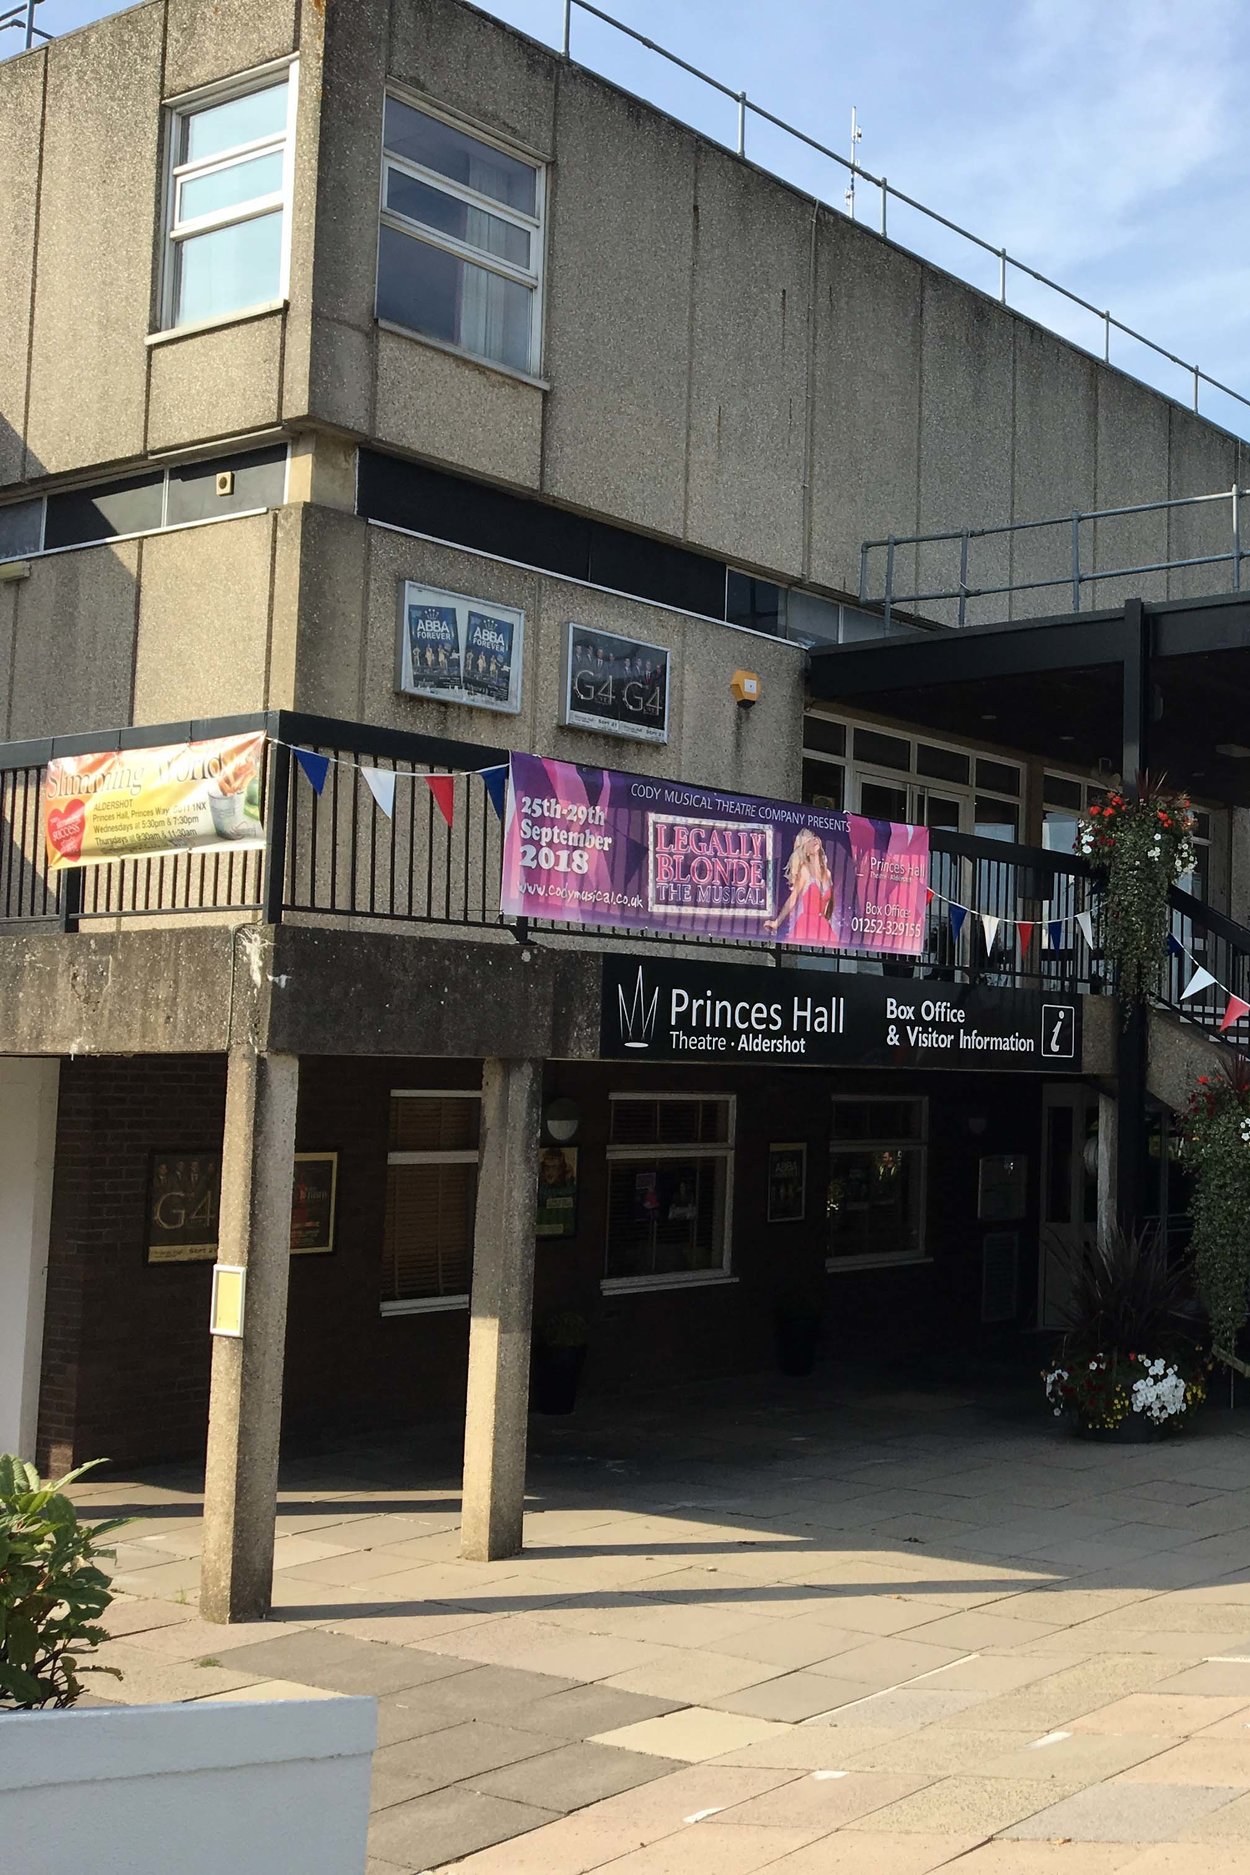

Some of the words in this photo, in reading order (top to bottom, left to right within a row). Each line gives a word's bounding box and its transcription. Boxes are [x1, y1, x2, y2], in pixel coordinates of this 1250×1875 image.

[416, 620, 450, 633] ABBA
[416, 631, 451, 640] FOREVER
[473, 627, 505, 645] ABBA
[472, 637, 505, 653] FOREVER
[573, 669, 616, 705] G4
[622, 681, 663, 715] G4
[47, 764, 144, 798] Slimming
[93, 799, 133, 812] ALDERSHOT
[93, 813, 115, 822] Princes
[131, 809, 154, 818] Princes
[521, 796, 605, 826] 25th-29th
[631, 783, 662, 799] CODY
[664, 789, 713, 810] MUSICAL
[715, 798, 757, 817] THEATRE
[758, 806, 806, 825] COMPANY
[807, 815, 851, 833] PRESENTS
[93, 823, 133, 834] Wednesdays
[141, 819, 165, 829] 5:30pm
[173, 815, 199, 825] 7:30pm
[520, 819, 613, 851] September
[95, 836, 128, 846] Thursdays
[136, 832, 160, 842] 9:30am
[655, 823, 766, 860] LEGALLY
[518, 844, 589, 875] 2018
[655, 853, 766, 888] BLONDE
[870, 857, 905, 874] Princes
[517, 882, 644, 909] www.codymusical.co.uk
[655, 882, 692, 902] THE
[697, 884, 766, 905] MUSICAL
[865, 901, 882, 916] Box
[670, 988, 782, 1031] Princes
[792, 996, 844, 1034] Hall
[886, 997, 915, 1020] Box
[921, 1000, 966, 1023] Office
[669, 1031, 727, 1050] Theatre
[738, 1034, 806, 1053] Aldershot
[886, 1025, 900, 1046] &
[907, 1025, 954, 1049] Visitor
[959, 1029, 1035, 1052] Information
[154, 1191, 216, 1230] G4
